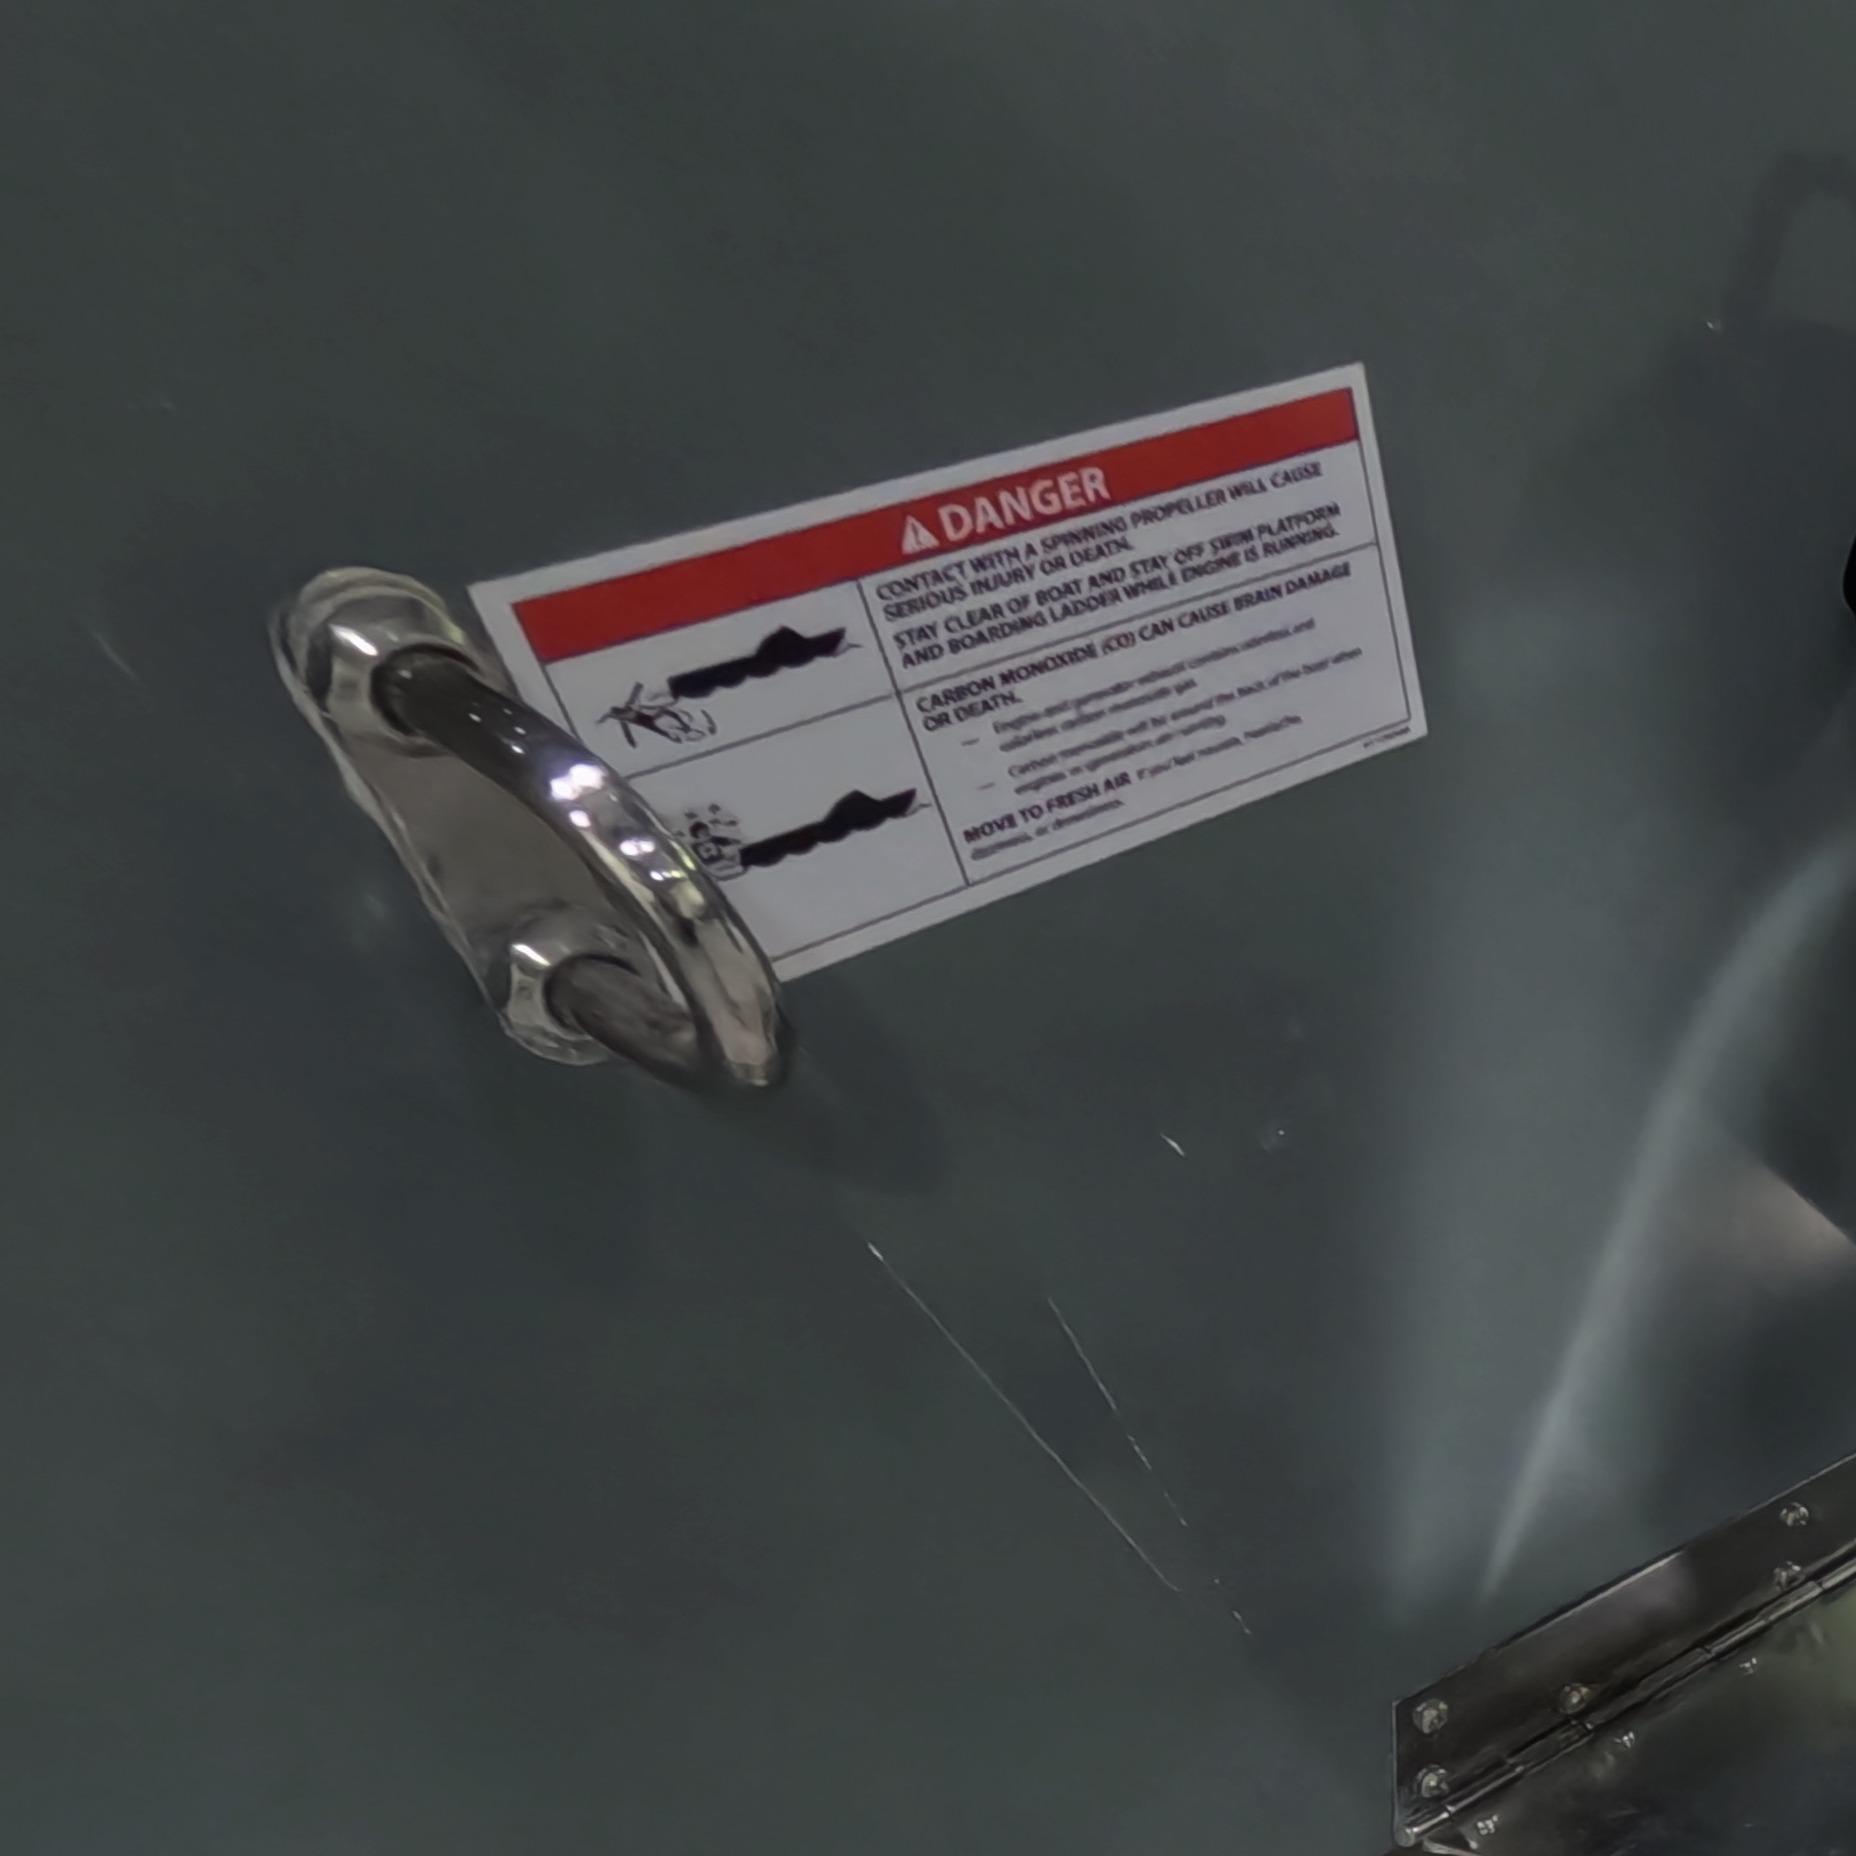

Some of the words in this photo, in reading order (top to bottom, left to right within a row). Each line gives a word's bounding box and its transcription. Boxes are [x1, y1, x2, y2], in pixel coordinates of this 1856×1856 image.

[876, 560, 965, 602] CONTACT
[969, 547, 1021, 574] WITH
[1024, 543, 1038, 561] A
[1040, 516, 1128, 551] SPINNING
[1130, 487, 1227, 528] PROPELLER
[1228, 478, 1269, 501] WILL
[1270, 461, 1323, 488] CAUSE
[937, 466, 1111, 542] DANGER
[883, 585, 969, 623] SERIOUS
[970, 563, 1036, 596] INJURY
[1039, 556, 1068, 575] OR
[893, 620, 939, 650] STAY
[944, 601, 1004, 634] CLEAR
[1007, 592, 1031, 613] OF
[1034, 579, 1083, 606] BOAT
[1087, 566, 1126, 588] AND
[1129, 554, 1169, 578] STAY
[1173, 543, 1205, 565] OFF
[1208, 528, 1254, 551] SWIM
[1256, 501, 1341, 538] PLATFORM
[901, 643, 945, 669] AND
[946, 611, 1049, 655] BOARDING
[1051, 591, 1122, 623] LADDER
[1122, 571, 1178, 602] WHILE
[1180, 552, 1243, 583] ENGINE
[1244, 546, 1258, 563] IS
[916, 676, 996, 714] CARBON
[998, 641, 1099, 686] MONOXIDE
[1101, 631, 1137, 656] (CO)
[1138, 618, 1175, 642] CAN
[1177, 599, 1231, 629] CAUSE
[1233, 582, 1284, 612] BRAIN
[1285, 561, 1351, 597] DAMAGE
[922, 713, 951, 732] OR
[962, 812, 1018, 844] MOVE
[1019, 803, 1044, 824] TO
[1046, 783, 1102, 814] FRESH
[1103, 771, 1132, 792] AIR
